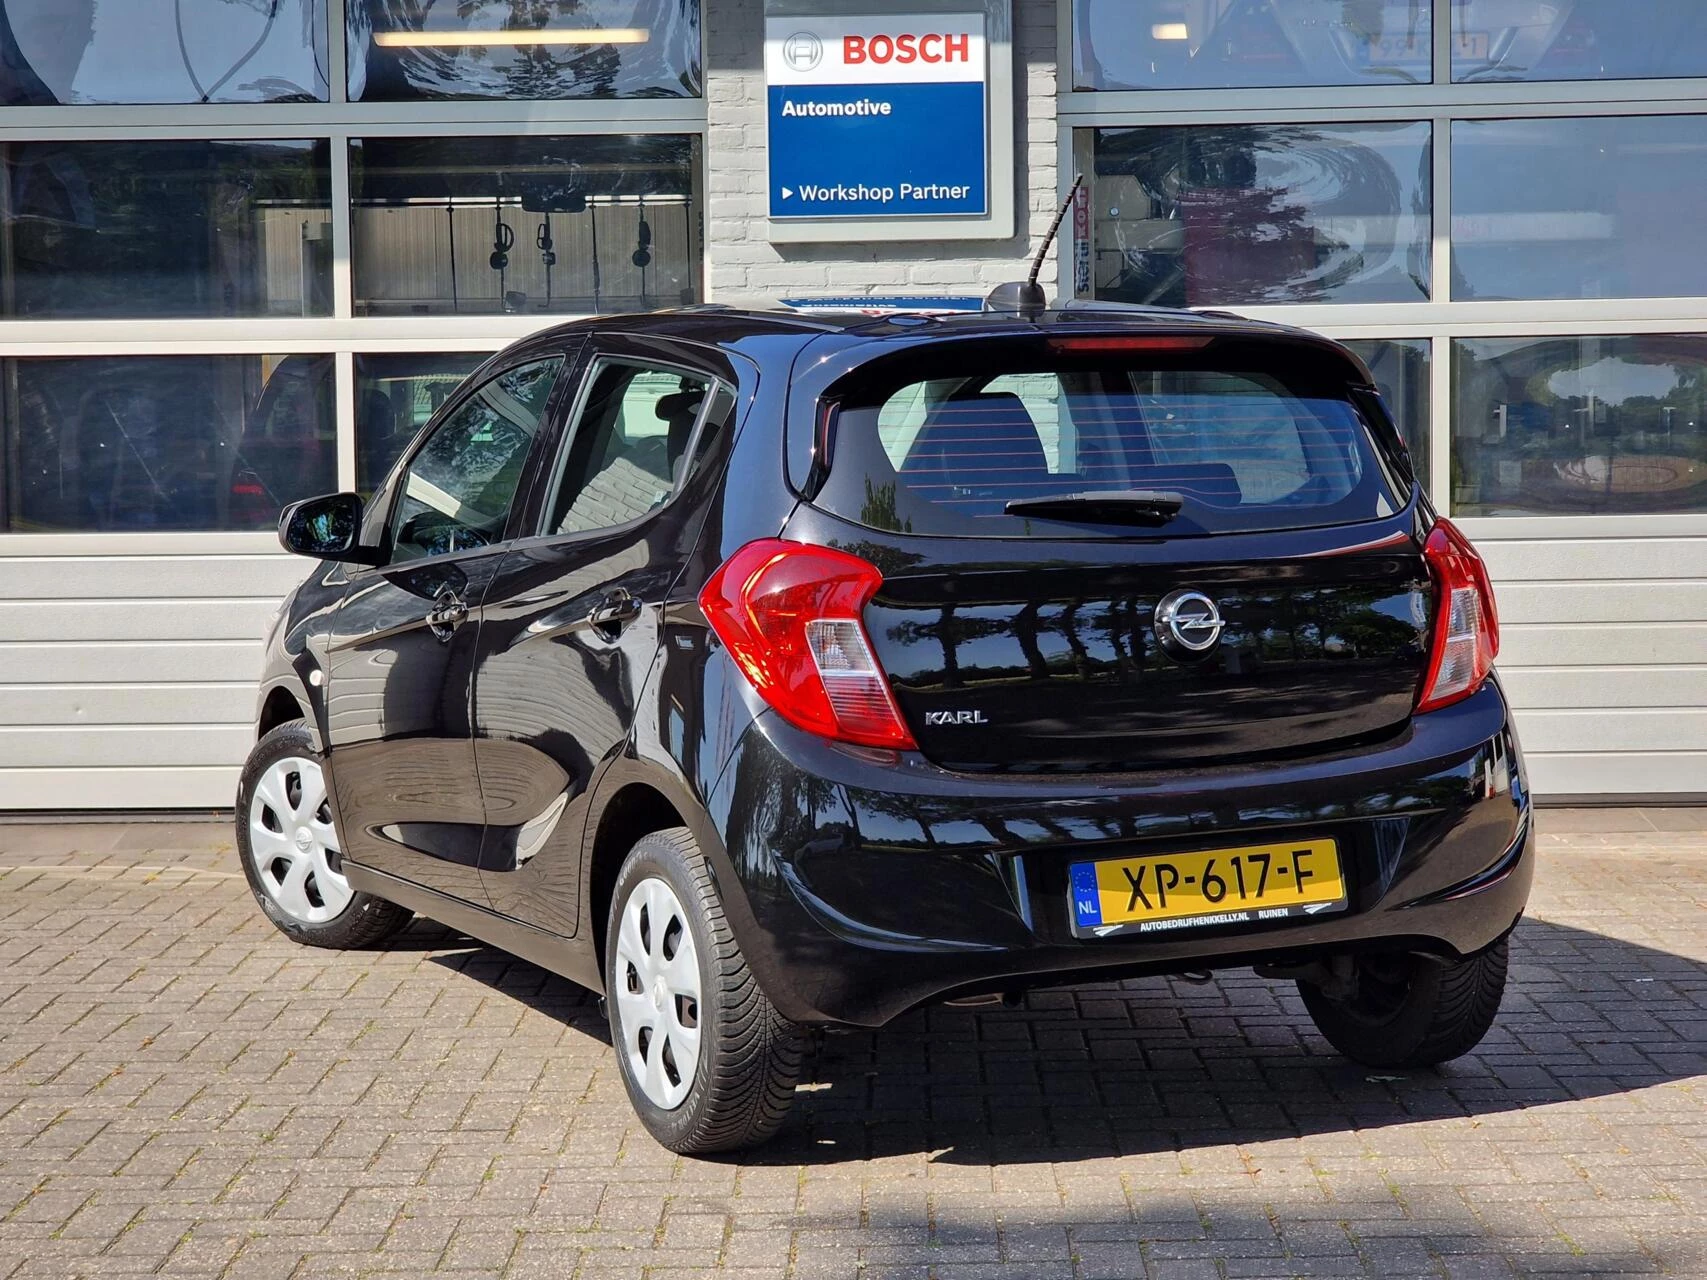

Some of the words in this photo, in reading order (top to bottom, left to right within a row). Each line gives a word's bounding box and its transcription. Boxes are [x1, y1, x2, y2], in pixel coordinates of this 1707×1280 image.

[843, 34, 969, 65] BOSCH
[782, 98, 892, 117] Automotive
[799, 184, 894, 204] Workshop
[900, 183, 971, 200] Partner
[925, 710, 989, 726] KARL
[1079, 900, 1097, 914] NL
[1122, 849, 1314, 912] XP-617-F
[1258, 907, 1289, 920] RUINEN
